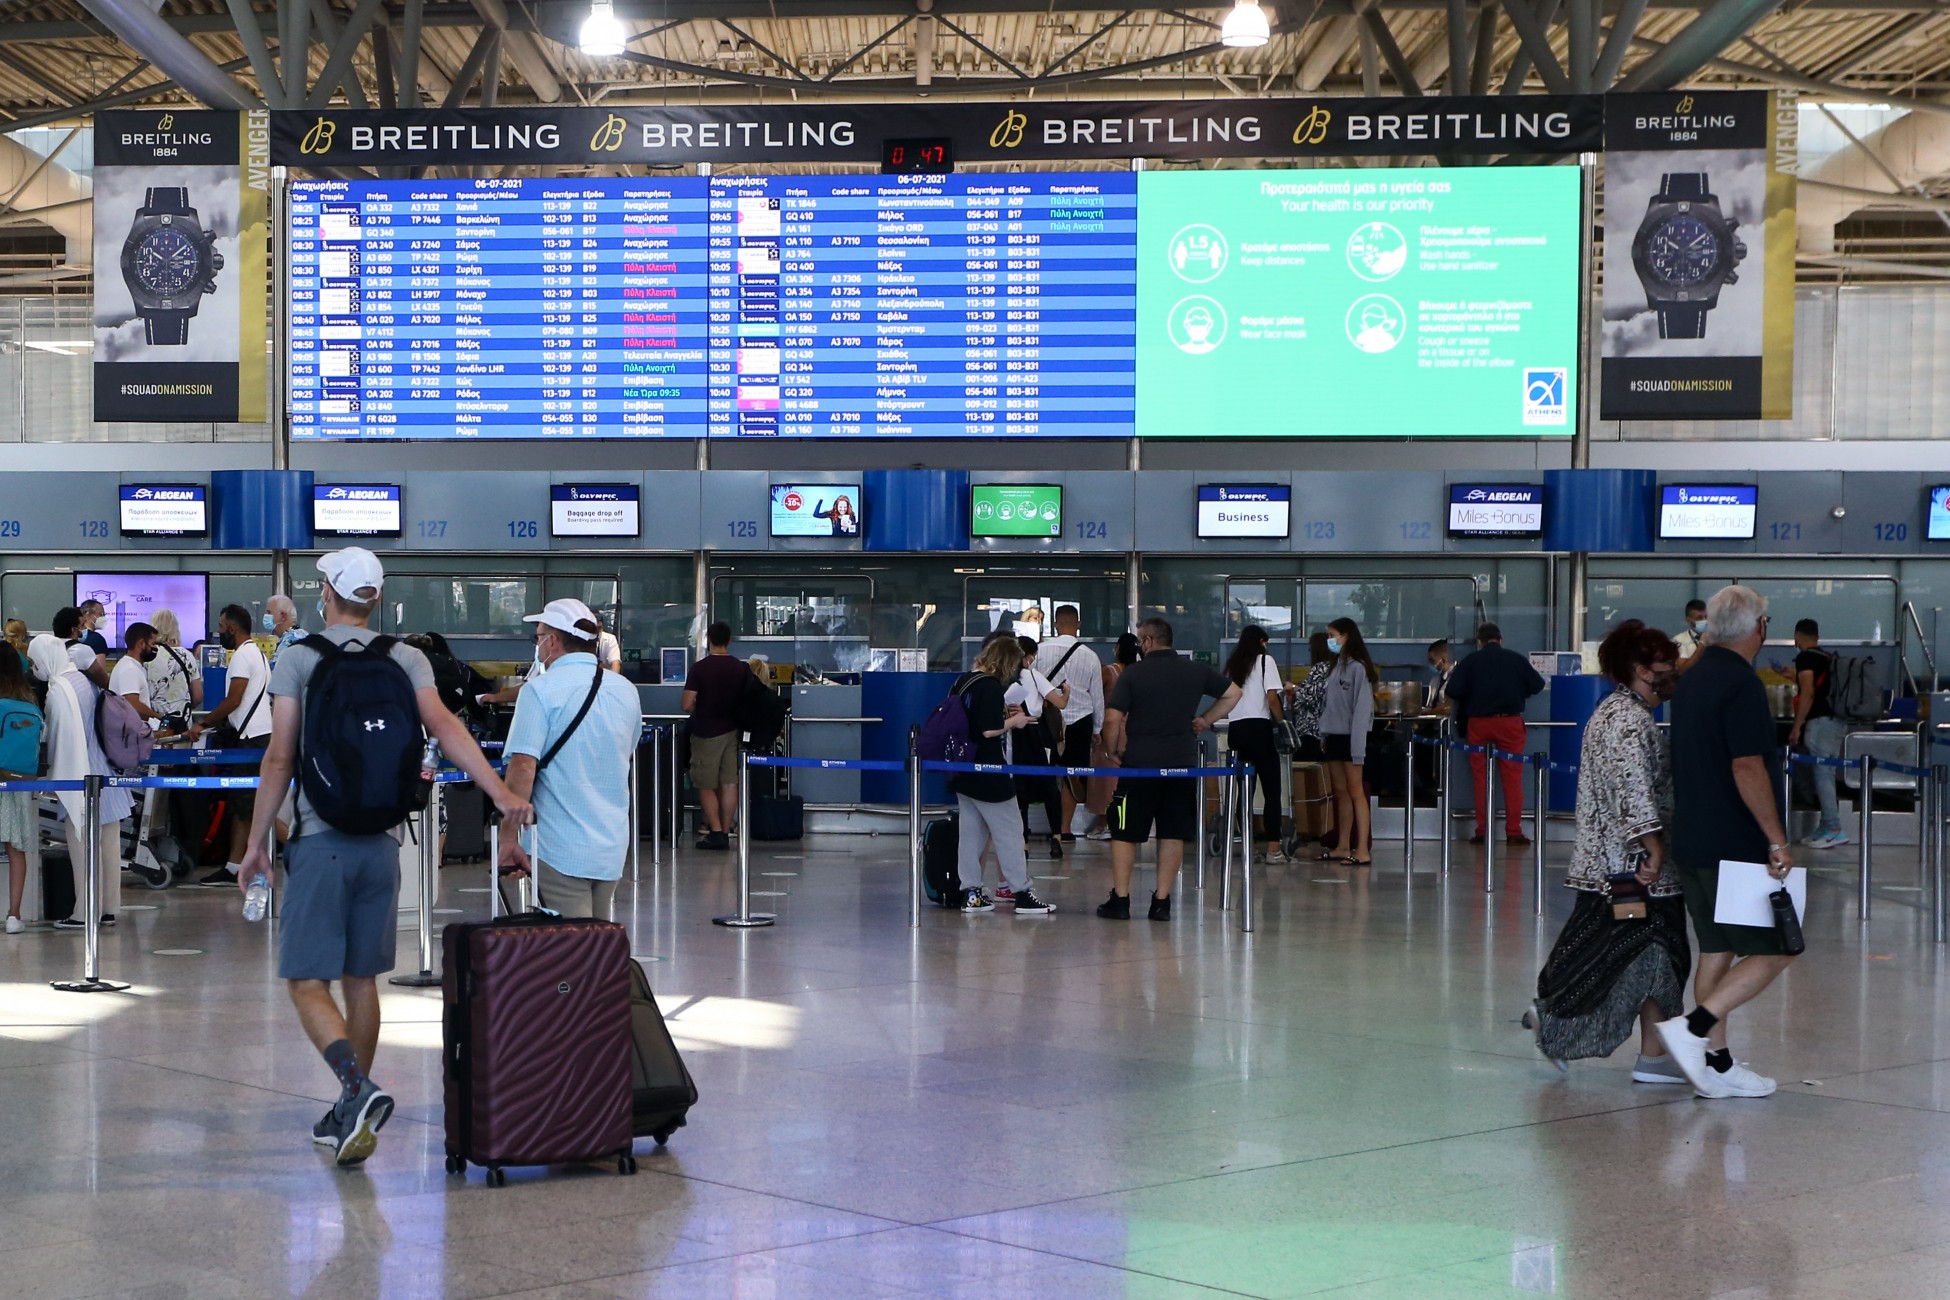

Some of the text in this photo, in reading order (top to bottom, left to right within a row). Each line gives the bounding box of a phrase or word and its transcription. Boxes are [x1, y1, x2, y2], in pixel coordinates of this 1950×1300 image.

[1348, 113, 1570, 140] BREITLING
[1636, 115, 1735, 129] BREITLING
[643, 122, 854, 147] BREITLING
[1044, 117, 1260, 143] BREITLING
[1776, 89, 1799, 175] AVENGER
[122, 134, 211, 144] BREITLING
[352, 125, 559, 150] BREITLING
[1671, 132, 1697, 141] 1884
[154, 148, 177, 156] 1884
[476, 179, 522, 188] 06-07-2021
[711, 177, 767, 188] Αναχωρήσεις
[898, 174, 946, 184] 06-07-2021
[293, 181, 348, 192] Αναχωρήσεις
[1354, 183, 1376, 196] μας
[1391, 180, 1424, 195] υγεία
[1428, 183, 1451, 192] σας
[1281, 198, 1434, 214] Your health is our priority
[710, 209, 1104, 221] 09:45 GQ 410 Μήλος 056-061 B17 Πύλη Ανοιχτή
[1189, 236, 1208, 248] 1.5
[1241, 256, 1305, 266] Keep distances
[366, 266, 376, 274] A3
[378, 266, 392, 274] 850
[456, 265, 482, 275] Ζυρίχη
[624, 263, 644, 272] Πύλη
[1240, 330, 1306, 338] Wear face mask
[378, 365, 392, 373] 600
[411, 365, 420, 373] TP
[422, 365, 440, 373] 7442
[543, 364, 572, 372] 102-139
[582, 364, 597, 372] A03
[624, 364, 644, 373] Πύλη
[646, 364, 675, 373] Ανοιχτή
[121, 385, 212, 395] #SQUADONAMISSION
[1631, 381, 1731, 392] #SQUADONAMISSION
[293, 390, 313, 398] 09:25
[366, 390, 378, 398] OA
[380, 390, 393, 398] 202
[411, 390, 422, 398] A3
[422, 390, 440, 398] 7202
[583, 389, 596, 397] B12
[293, 415, 314, 423] 09:30
[456, 414, 482, 422] Μάλτα
[542, 414, 573, 422] 054-055
[582, 414, 597, 422] B30
[624, 413, 664, 423] Επιβίβαση
[154, 491, 194, 500] AEGEAN
[347, 490, 388, 500] AEGEAN
[1488, 492, 1530, 501] AEGEAN
[1690, 495, 1739, 503] OLYMPIC
[1218, 512, 1269, 522] Business
[1458, 509, 1488, 524] Miles
[1669, 514, 1700, 528] Miles
[80, 520, 108, 537] 128
[418, 521, 448, 538] 127
[508, 521, 537, 538] 126
[728, 521, 757, 538] 125
[1077, 522, 1107, 538] 124
[1304, 522, 1335, 540] 123
[1400, 523, 1430, 540] 122
[1770, 524, 1802, 540] 121
[1874, 524, 1907, 540] 120
